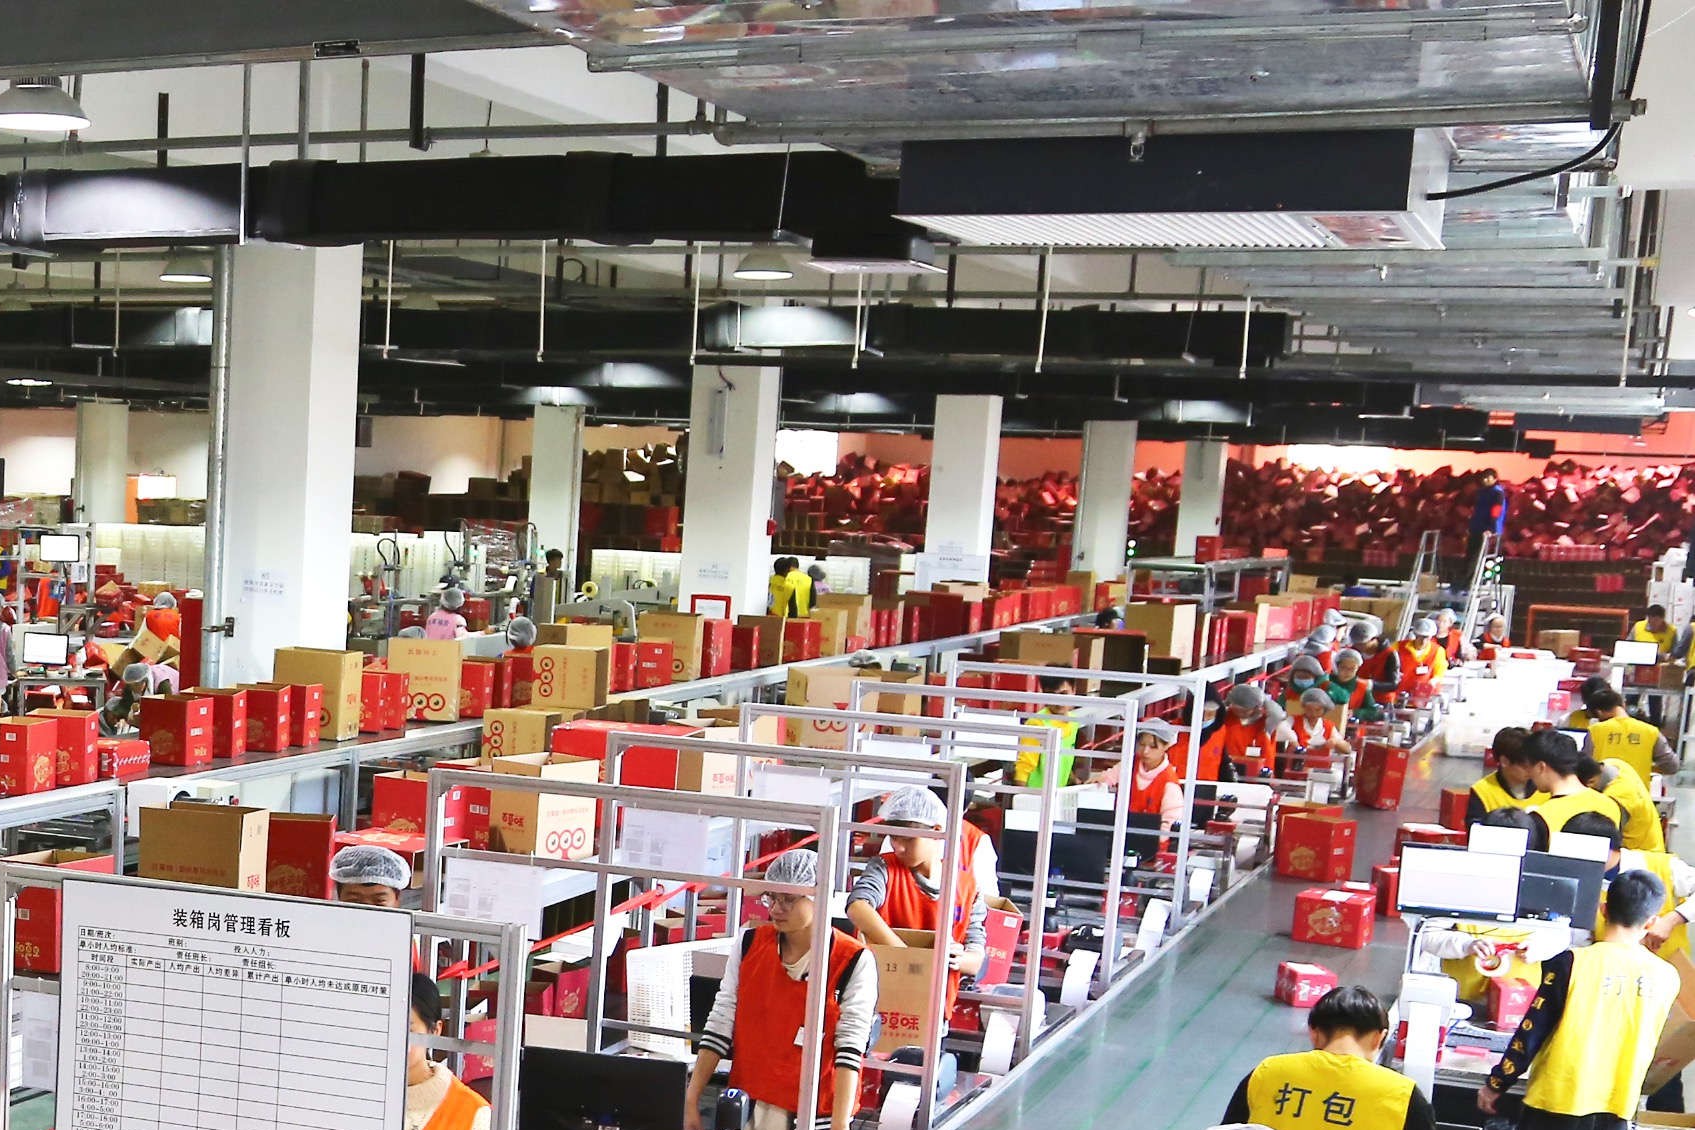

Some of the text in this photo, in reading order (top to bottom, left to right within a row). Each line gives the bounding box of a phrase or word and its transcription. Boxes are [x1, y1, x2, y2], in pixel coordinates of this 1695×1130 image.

[172, 908, 291, 939] 装箱岗管理看板
[91, 953, 114, 963] 时间段
[169, 962, 200, 974] 人均产出
[1274, 1081, 1357, 1127] 打包
